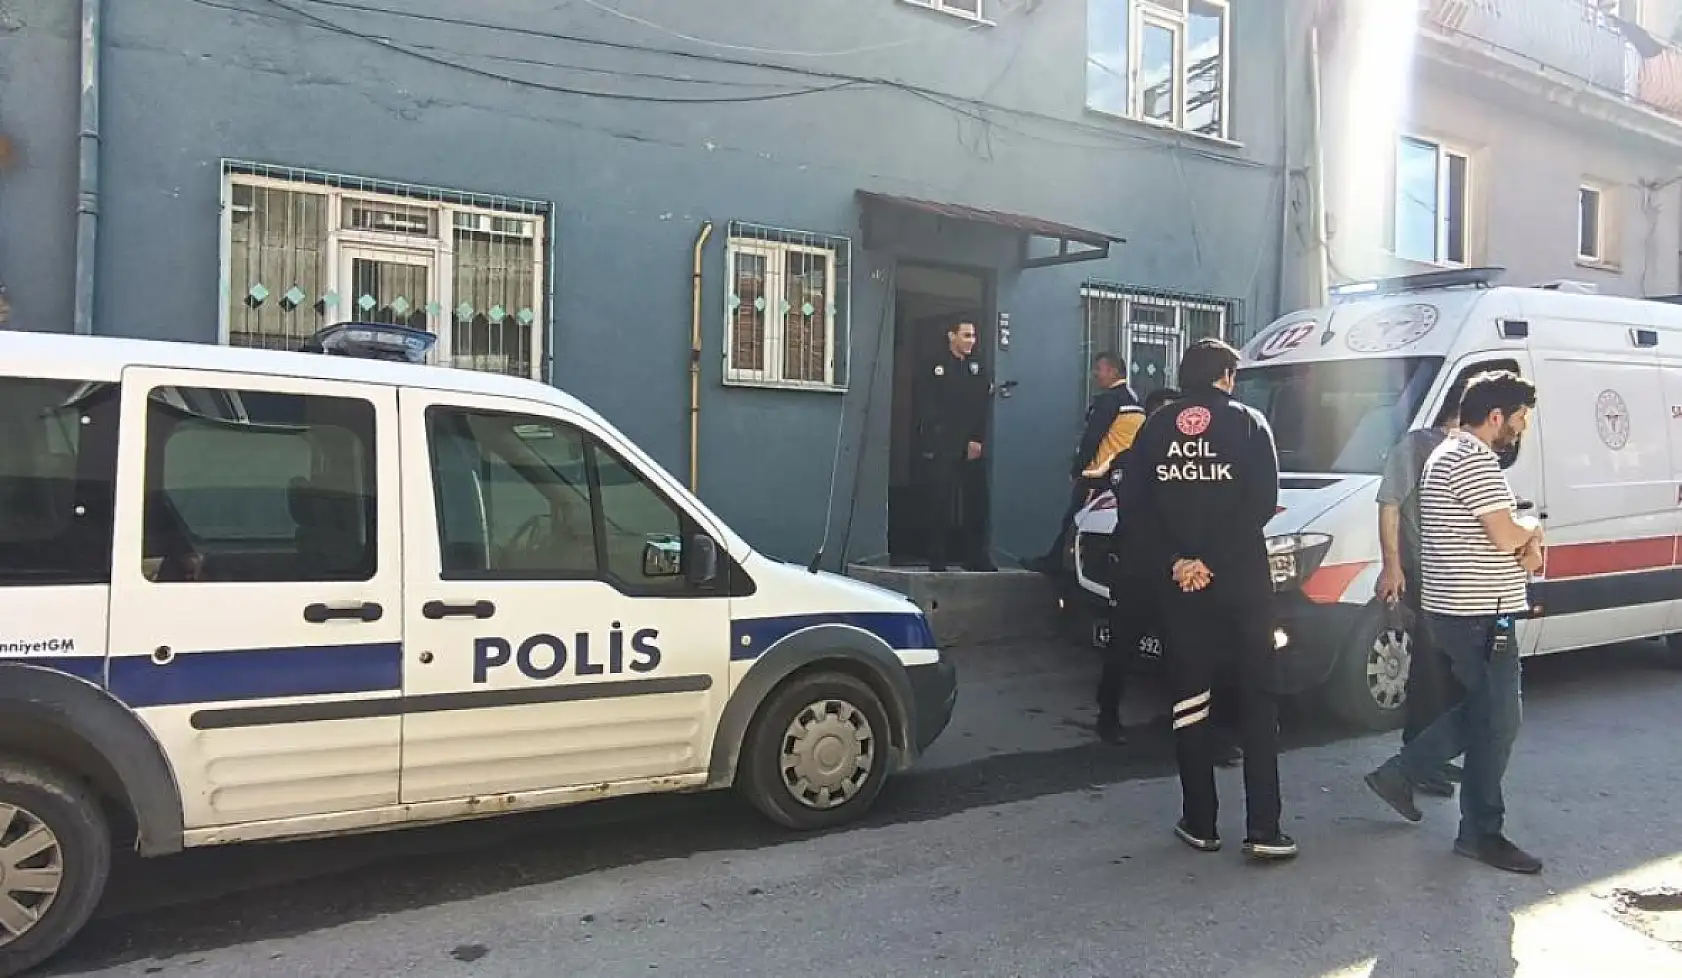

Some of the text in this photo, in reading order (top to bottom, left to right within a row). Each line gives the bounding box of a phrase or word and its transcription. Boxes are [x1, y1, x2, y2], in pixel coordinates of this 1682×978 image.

[1167, 438, 1217, 458] ACİL
[1156, 461, 1233, 481] SAĞLIK
[473, 620, 661, 683] POLİS
